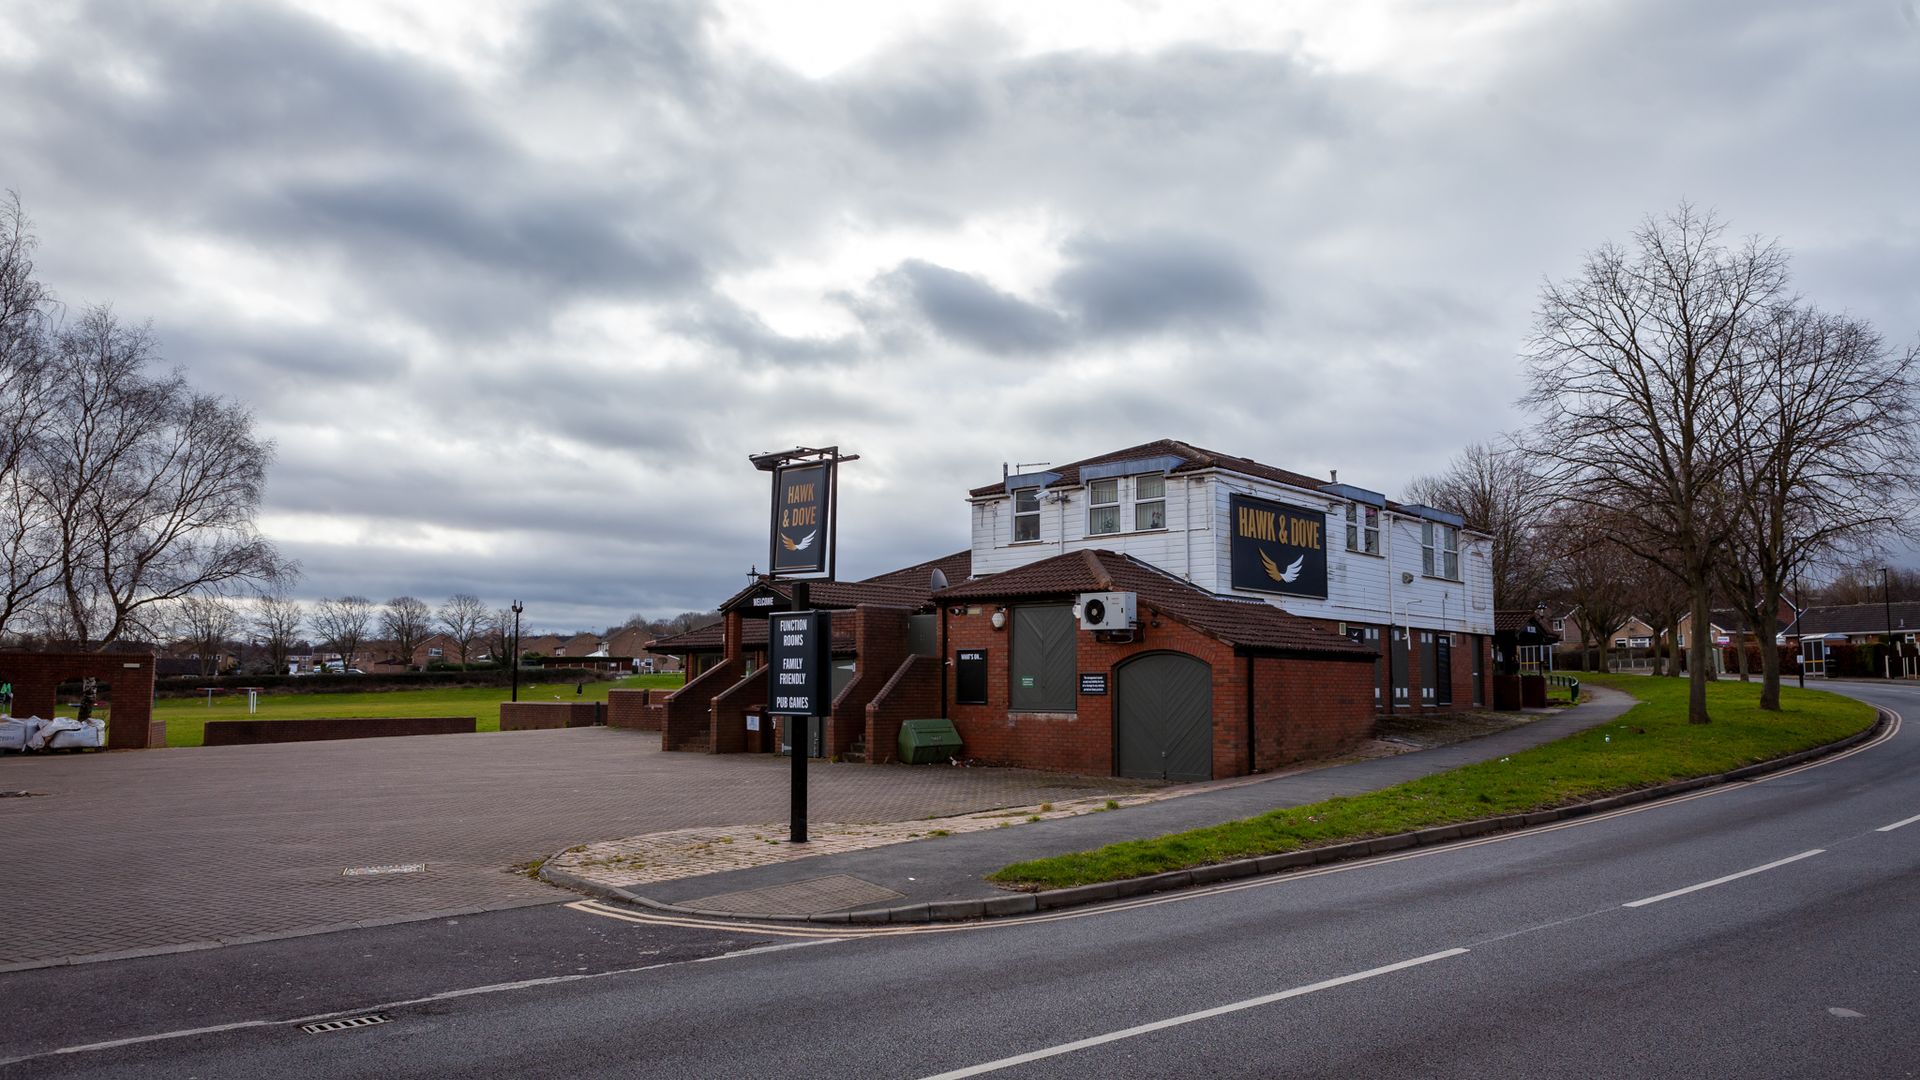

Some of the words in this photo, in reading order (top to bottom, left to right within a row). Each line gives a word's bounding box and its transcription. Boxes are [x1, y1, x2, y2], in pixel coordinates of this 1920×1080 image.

[788, 483, 815, 504] HAWK
[783, 509, 789, 528] &
[792, 506, 816, 526] DOVE
[1239, 506, 1276, 542] HAWK
[1279, 515, 1288, 544] &
[1291, 518, 1320, 549] DOVE
[753, 597, 774, 606] WELCOME
[780, 619, 808, 631] FUNCTION
[783, 635, 804, 646] ROOMS
[783, 658, 803, 669] FAMILY
[780, 673, 806, 685] FRIENDLY
[776, 697, 788, 708] PUB
[789, 697, 808, 709] GAMES
